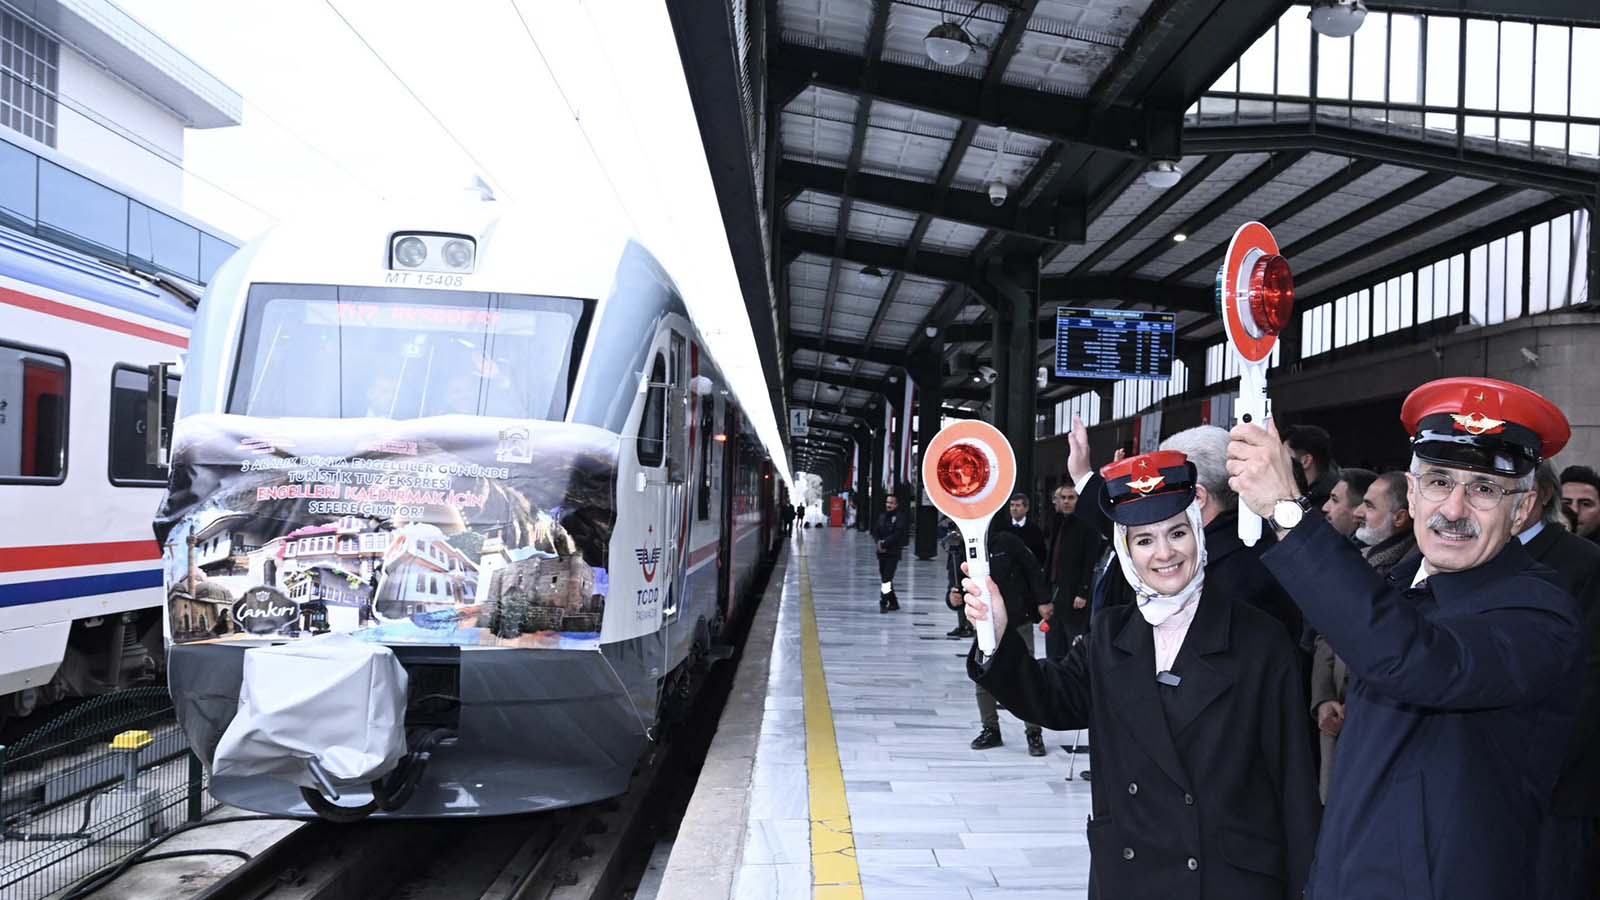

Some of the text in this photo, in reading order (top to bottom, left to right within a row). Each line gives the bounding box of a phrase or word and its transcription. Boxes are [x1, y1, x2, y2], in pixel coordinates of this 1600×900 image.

[385, 272, 464, 287] MT 15408
[240, 459, 250, 473] 3
[288, 468, 352, 485] TURİSTİK
[354, 472, 384, 486] TUZ
[257, 483, 340, 502] ENGELLERİ
[344, 484, 446, 505] KALDIRMAK
[308, 500, 425, 518] SEFERE ÇIKIYOR!
[637, 587, 659, 605] TCDD
